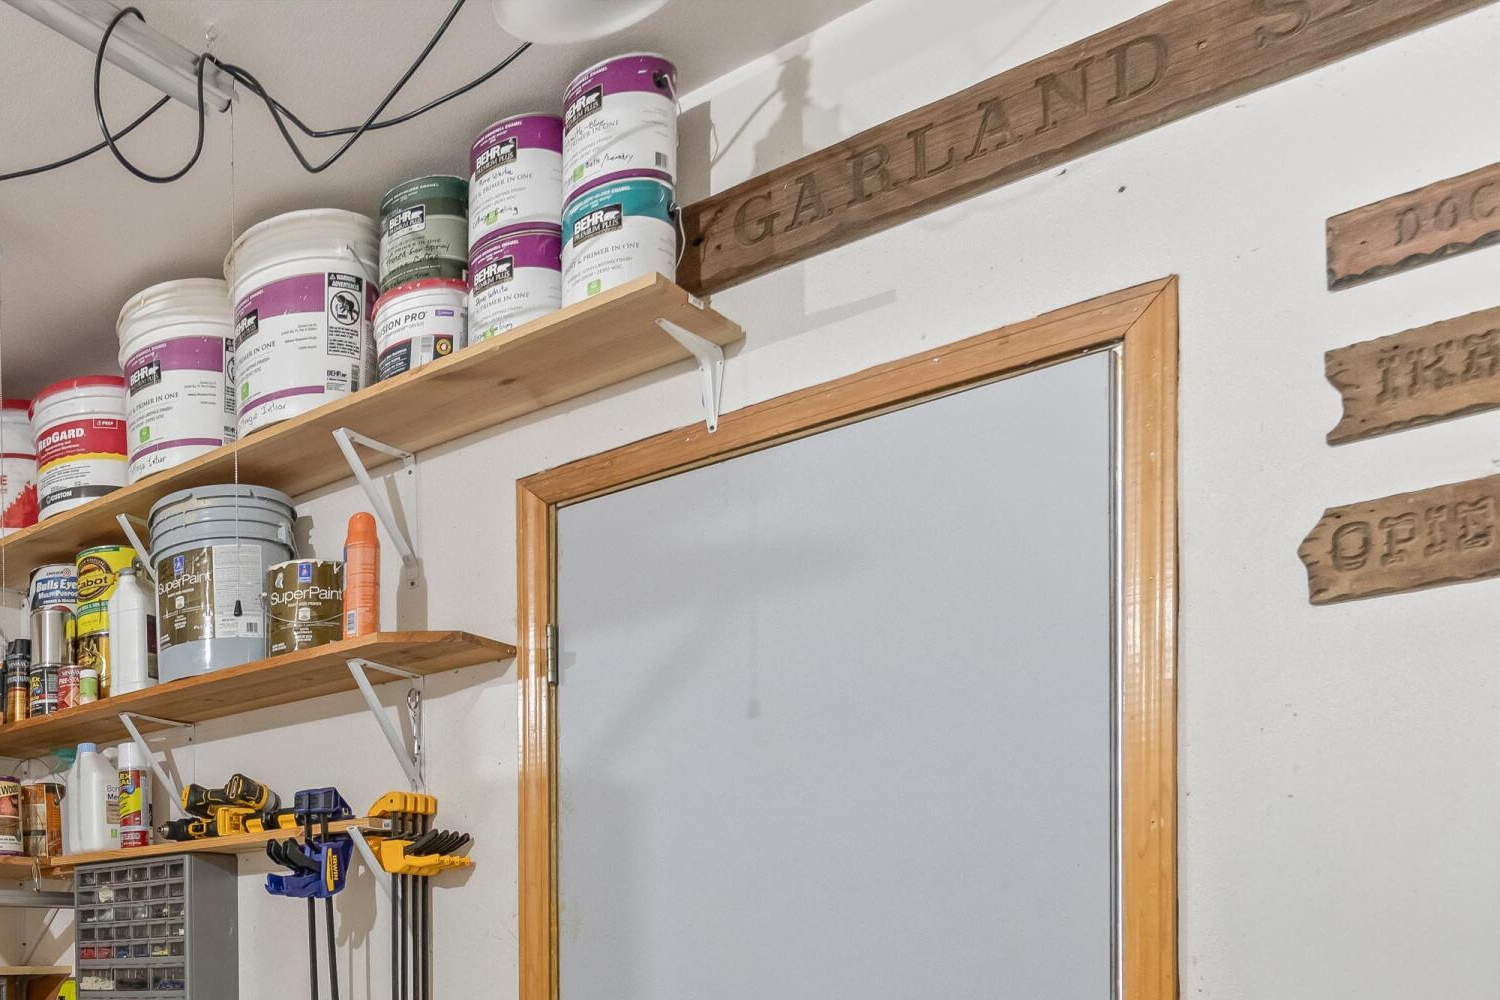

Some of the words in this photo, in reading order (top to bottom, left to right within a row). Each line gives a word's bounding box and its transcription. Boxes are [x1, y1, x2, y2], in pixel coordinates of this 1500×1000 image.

[733, 34, 1170, 247] GARLAND
[476, 145, 501, 169] BEHR
[389, 210, 412, 230] BEHR
[574, 210, 605, 236] BEHR
[474, 263, 498, 286] BEHR
[131, 367, 149, 385] BEHR
[164, 392, 179, 400] ONE
[50, 490, 72, 501] CUSTOM
[36, 580, 59, 593] Bulls
[60, 578, 77, 590] Eye
[270, 586, 343, 606] SuperPaint
